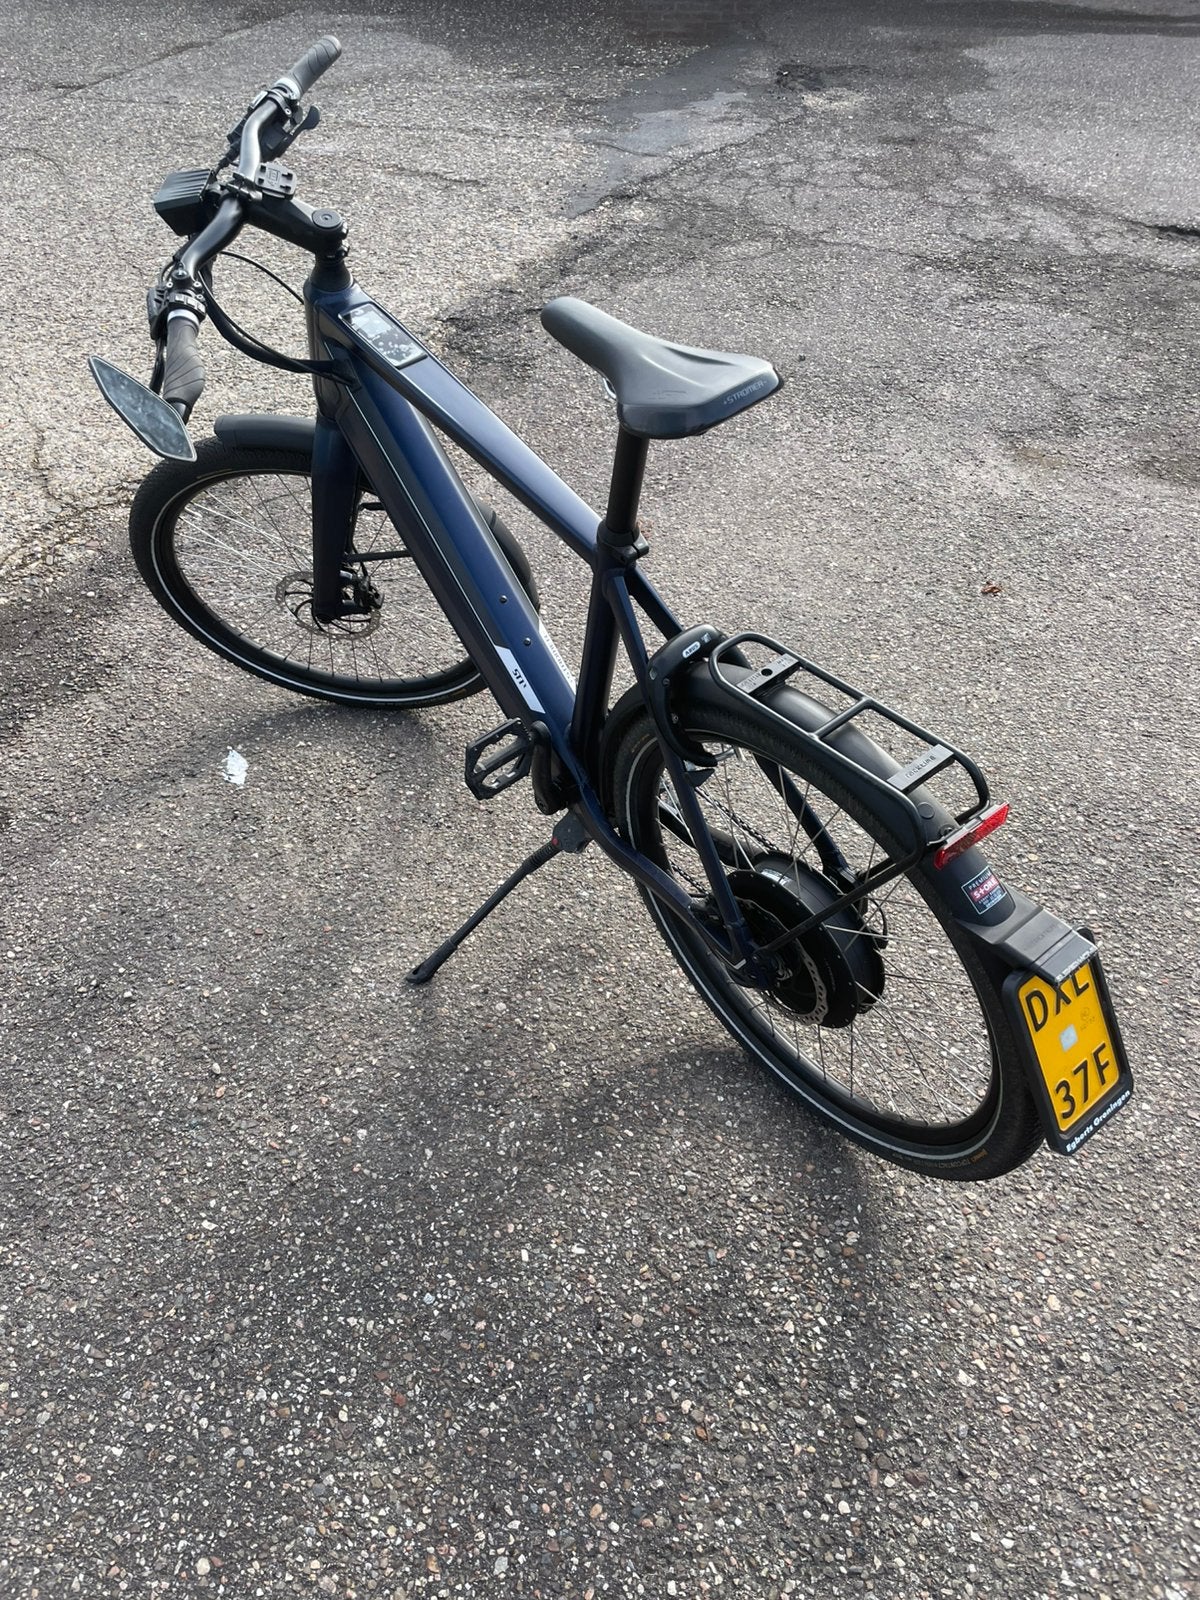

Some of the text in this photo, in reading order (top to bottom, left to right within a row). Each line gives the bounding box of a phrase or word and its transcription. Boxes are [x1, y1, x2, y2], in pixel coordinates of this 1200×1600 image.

[727, 381, 764, 403] STROMER
[685, 644, 699, 656] ABUS
[968, 870, 992, 890] PREMIUM
[1025, 972, 1090, 1033] DXL
[1055, 1042, 1110, 1120] 37F
[1066, 1090, 1130, 1153] Egberts Groningen
